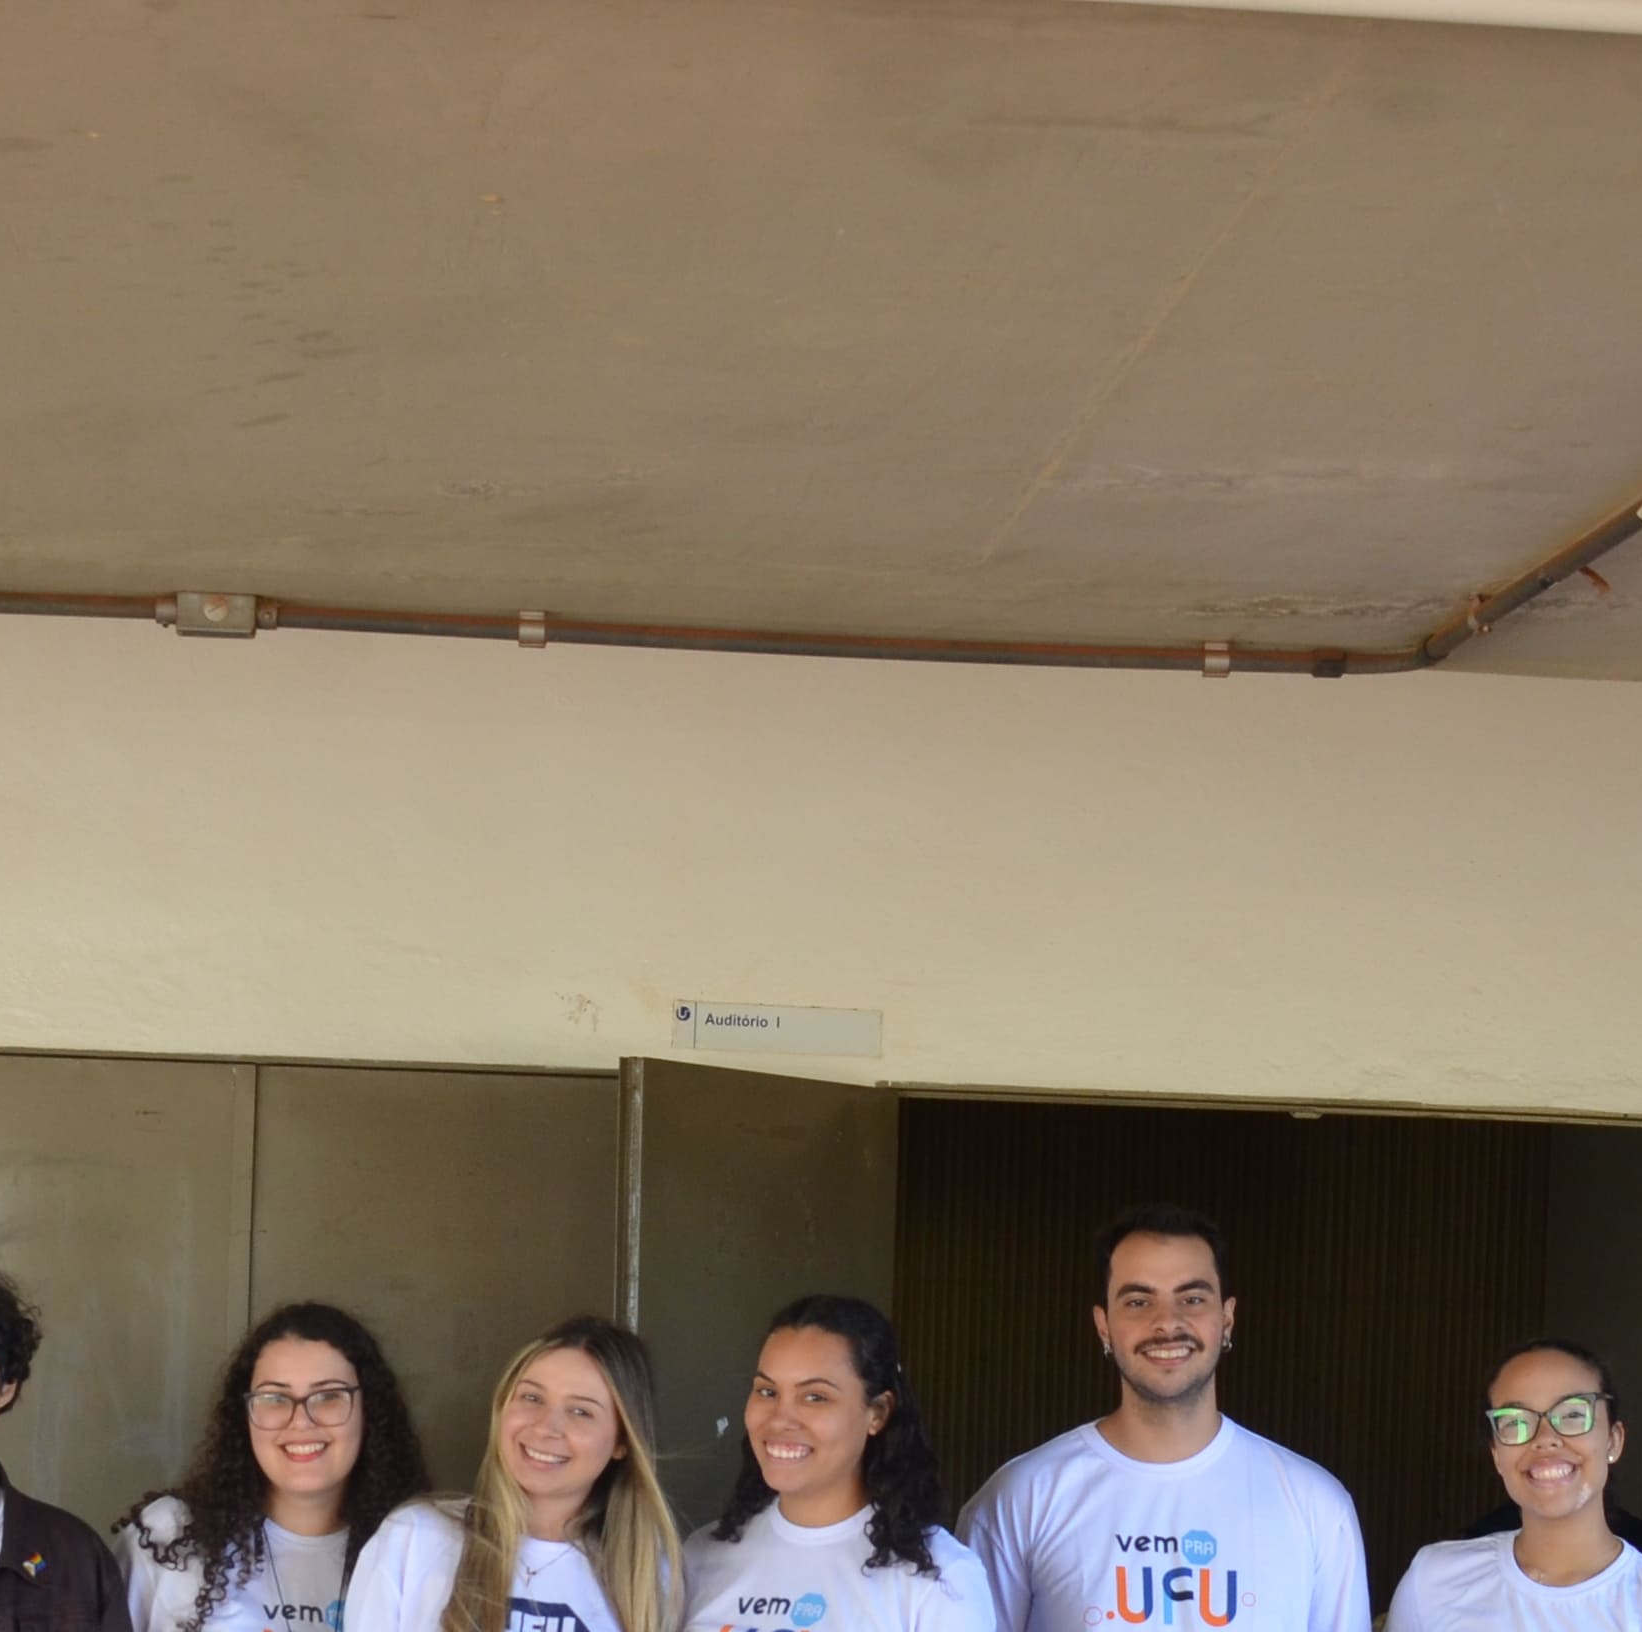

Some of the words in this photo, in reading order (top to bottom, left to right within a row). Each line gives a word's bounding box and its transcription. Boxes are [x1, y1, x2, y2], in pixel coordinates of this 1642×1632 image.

[705, 1013, 768, 1028] Auditório
[1115, 1533, 1179, 1554] vem
[1184, 1539, 1215, 1556] PRA
[737, 1595, 791, 1616] vem
[793, 1599, 824, 1619] PRA
[1115, 1566, 1237, 1627] UFU
[262, 1603, 324, 1623] vem
